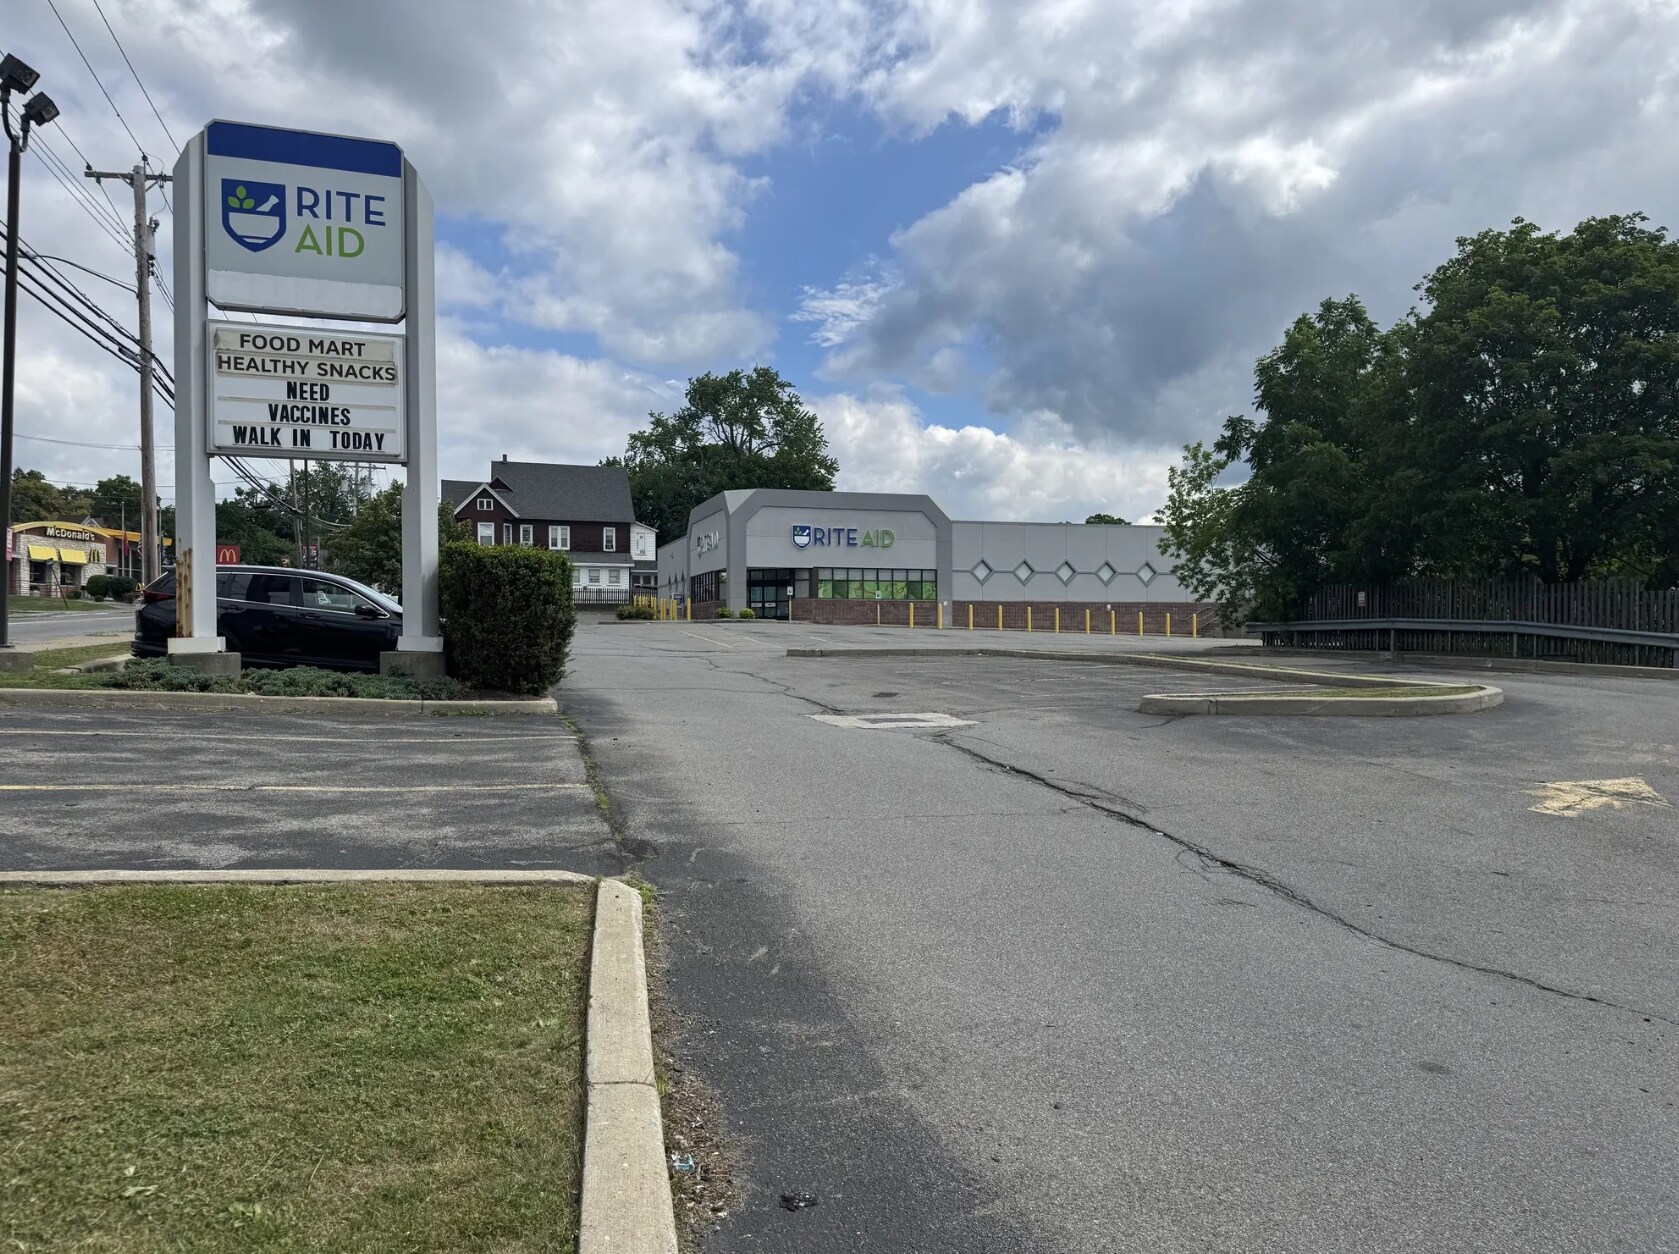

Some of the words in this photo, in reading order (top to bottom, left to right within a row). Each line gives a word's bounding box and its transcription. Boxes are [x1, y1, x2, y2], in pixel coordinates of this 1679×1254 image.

[297, 186, 386, 226] RITE
[294, 223, 365, 258] AID
[240, 334, 300, 352] FOOD
[309, 339, 366, 357] MART
[218, 355, 309, 375] HEALTHY
[317, 362, 396, 381] SNACKS
[287, 381, 330, 401] NEED
[268, 404, 351, 426] VACCINES
[233, 426, 282, 446] WALK
[292, 429, 311, 447] IN
[330, 431, 385, 451] TODAY
[46, 526, 95, 541] McDonald's
[814, 527, 858, 547] RITE
[860, 529, 895, 548] AID
